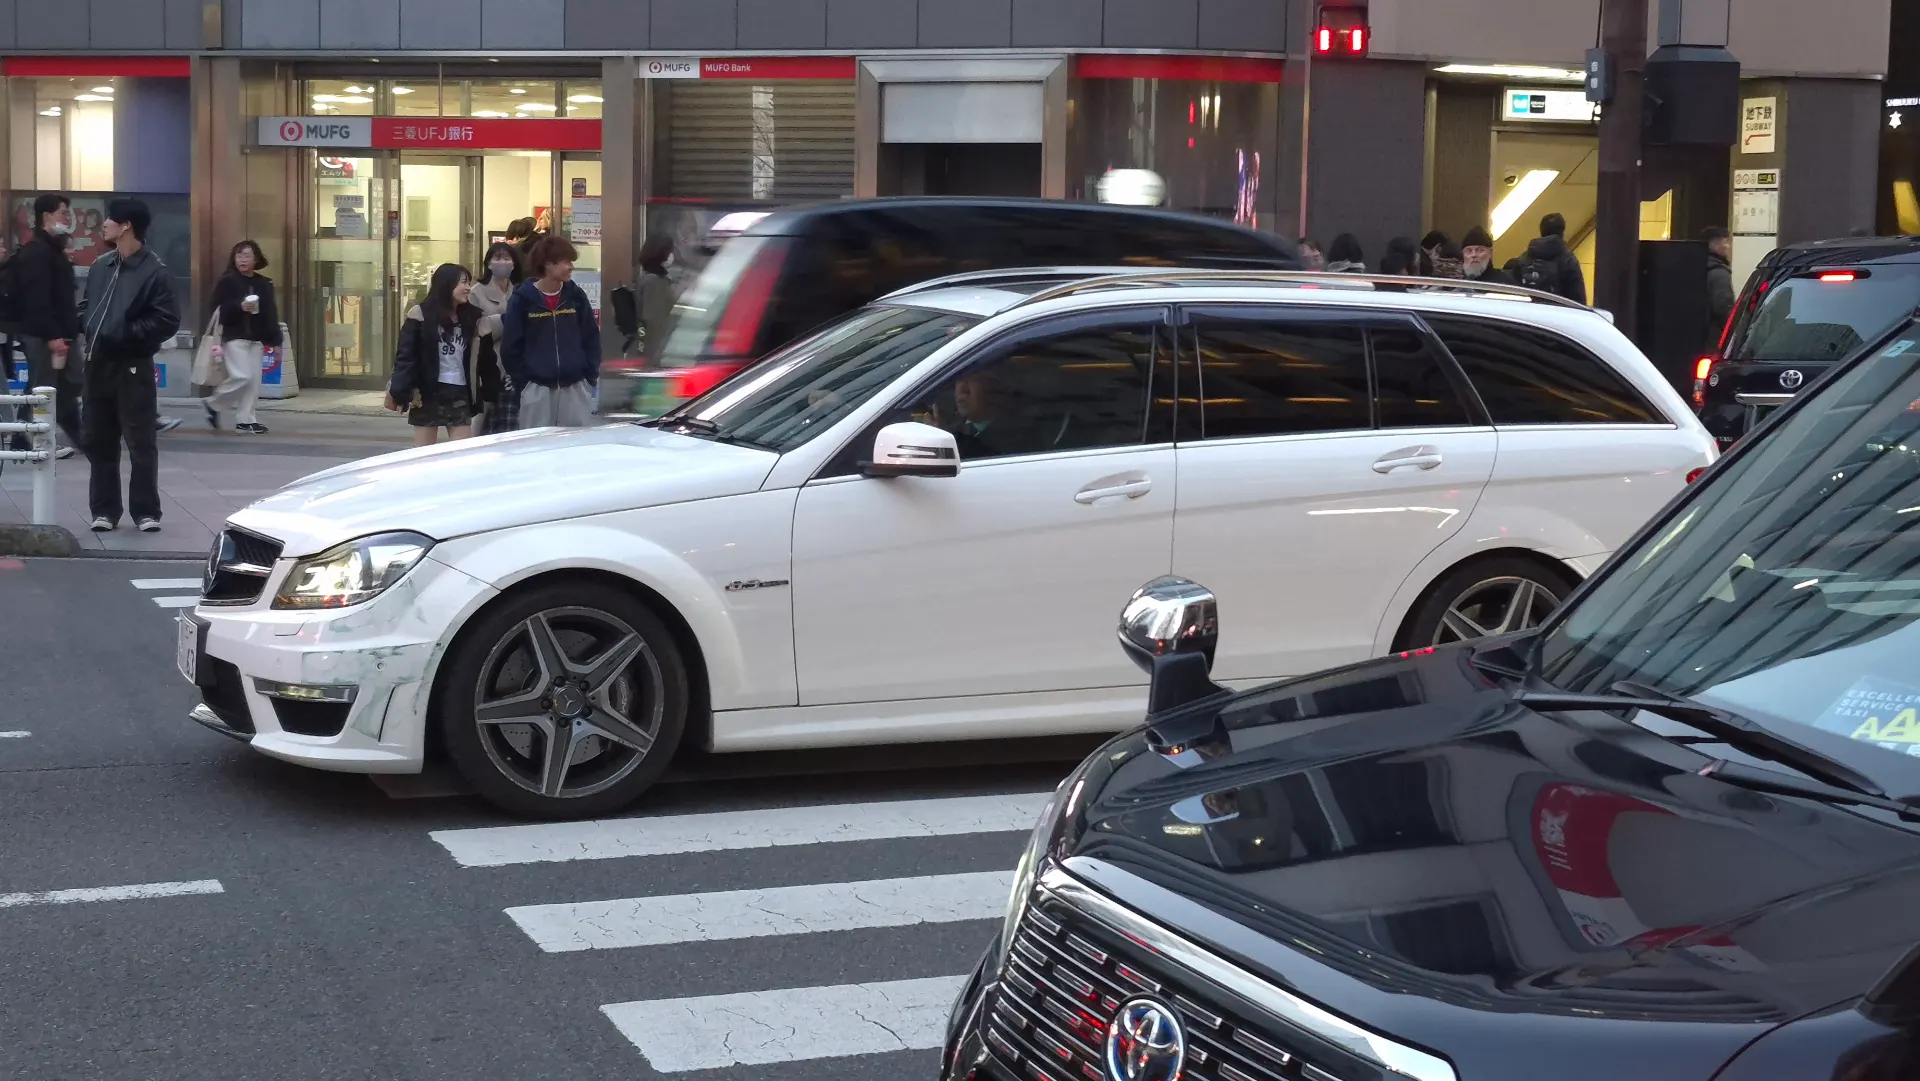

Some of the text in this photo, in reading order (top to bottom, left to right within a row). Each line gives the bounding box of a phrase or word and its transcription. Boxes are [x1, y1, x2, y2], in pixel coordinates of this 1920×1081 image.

[664, 63, 690, 72] MUFG
[705, 63, 751, 72] MUFG Bank
[1745, 106, 1772, 120] 地下鉄
[306, 124, 350, 139] MUFG
[1745, 122, 1772, 131] SUBWAY
[392, 125, 474, 141] 三菱UFJ銀行
[442, 345, 456, 355] 99
[1840, 699, 1905, 712] SERVICE
[1834, 707, 1868, 718] TAXI
[1849, 707, 1920, 744] AA
